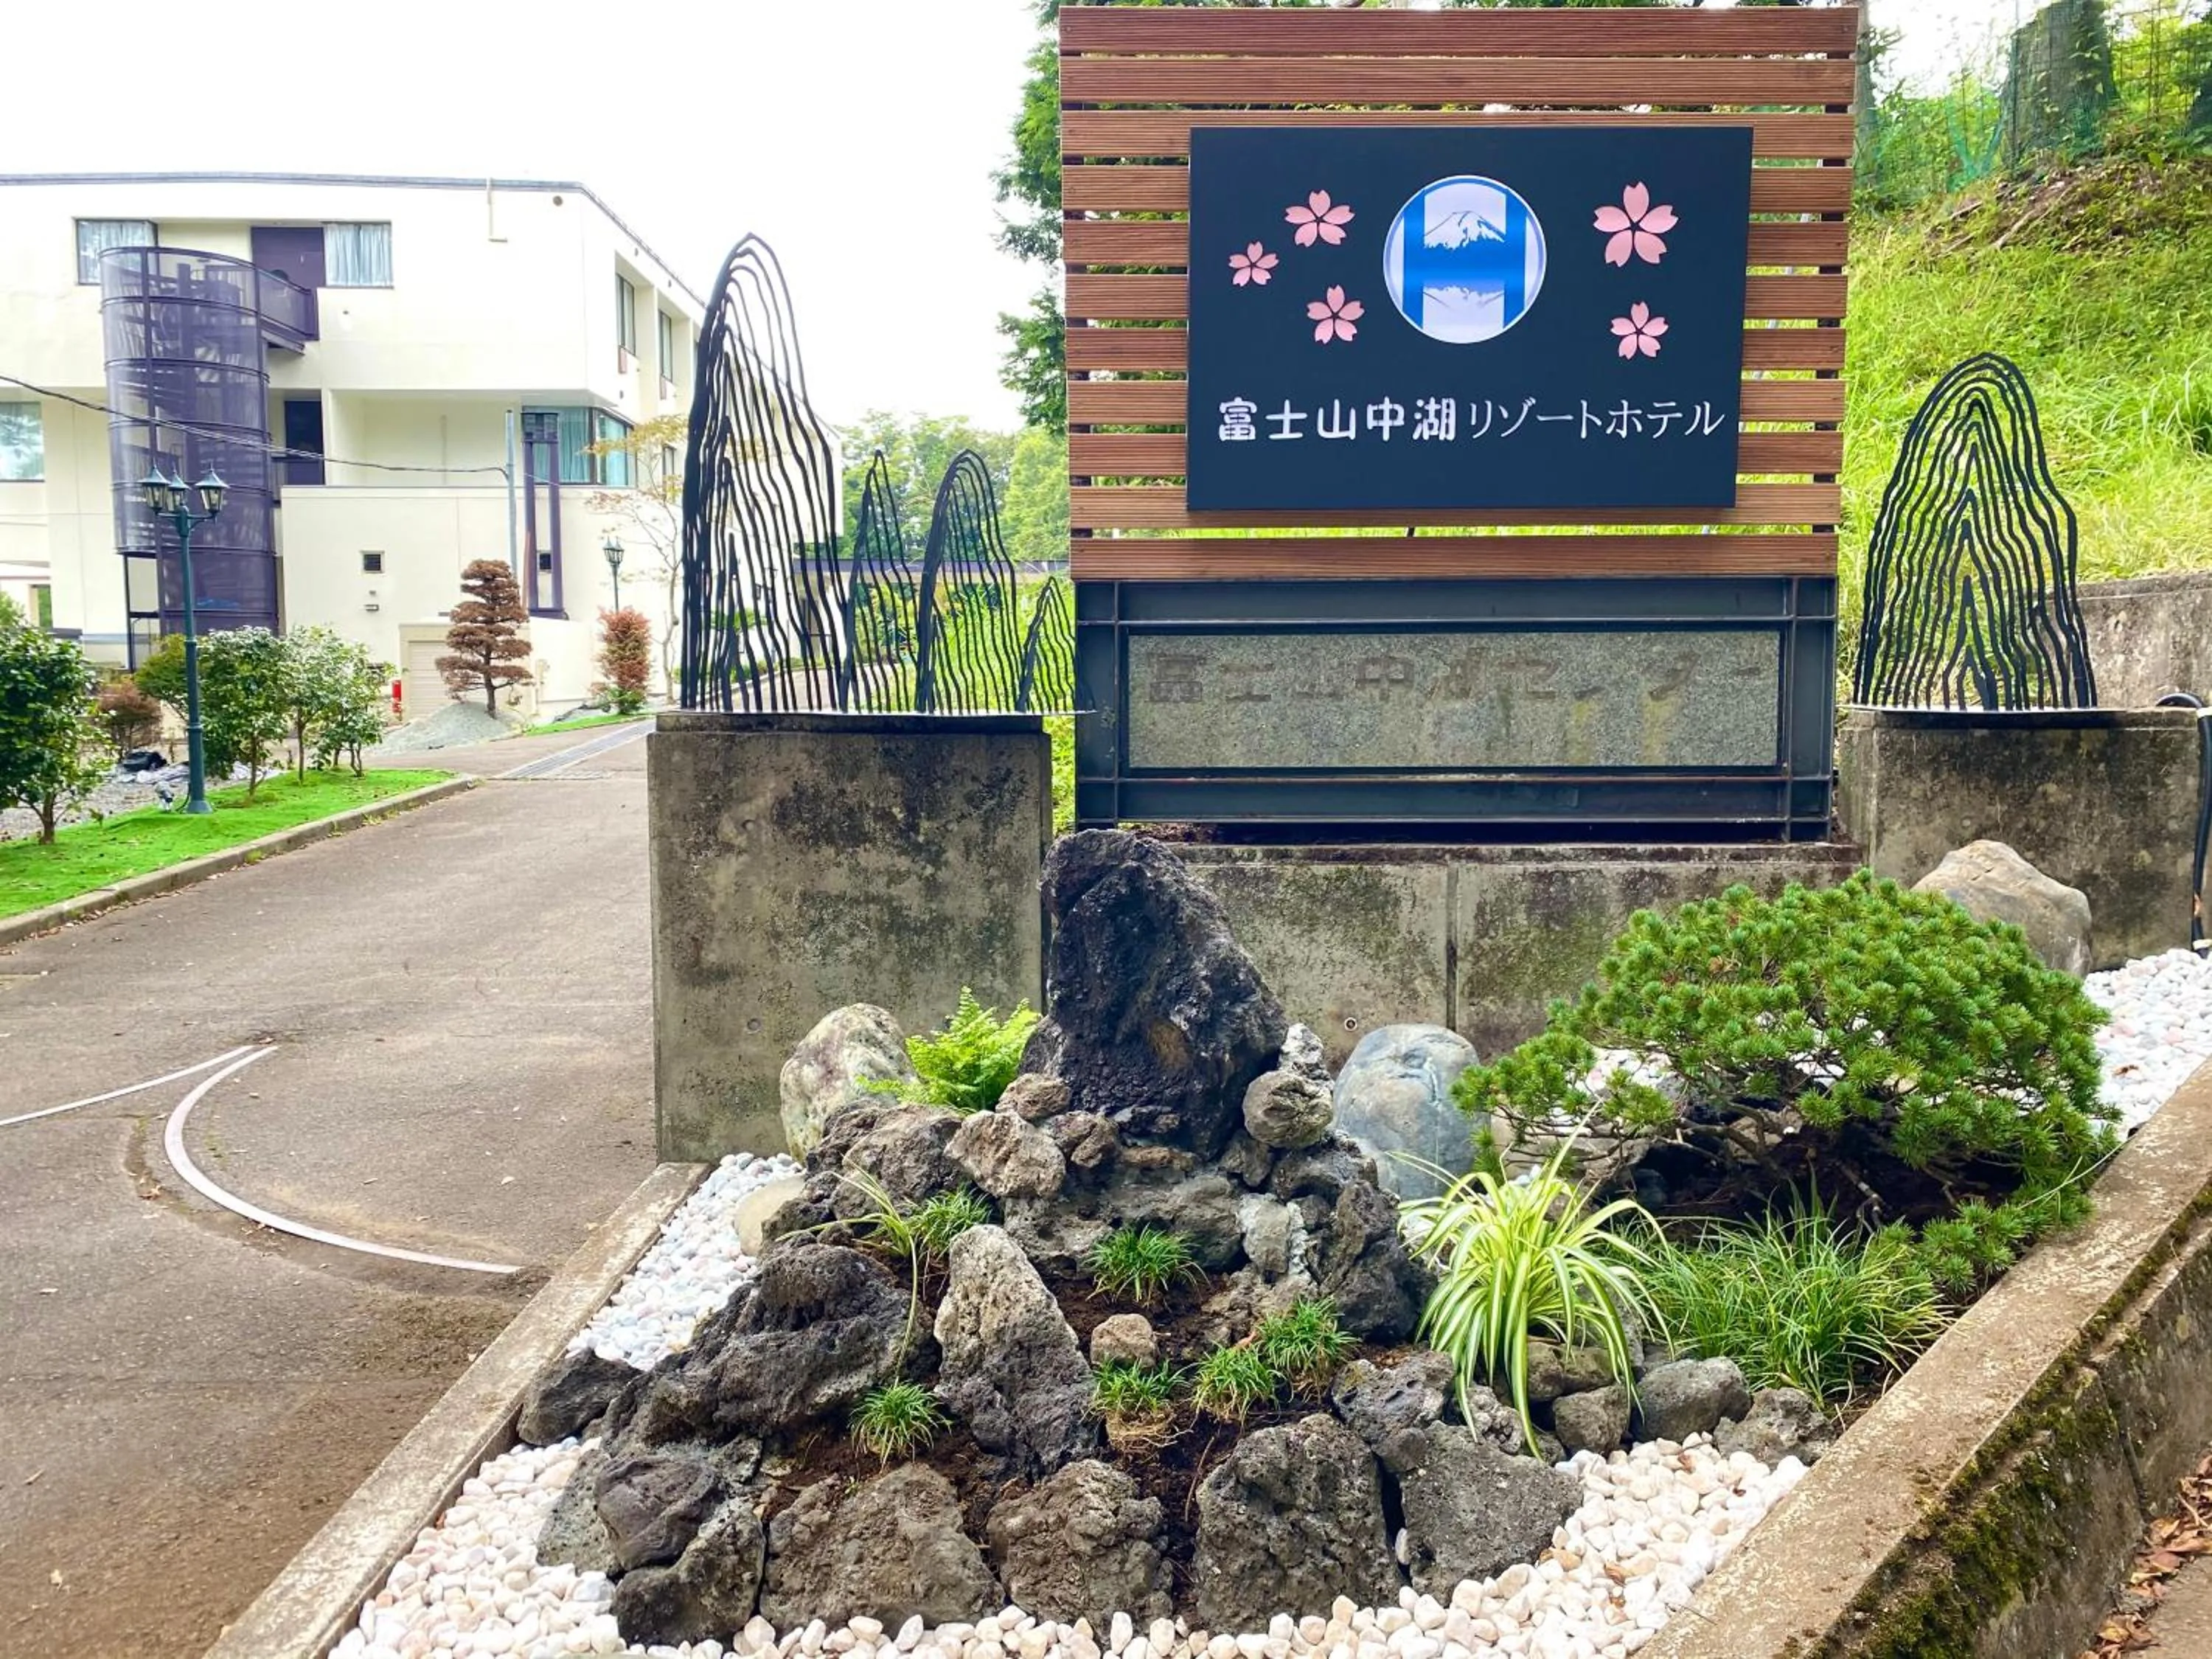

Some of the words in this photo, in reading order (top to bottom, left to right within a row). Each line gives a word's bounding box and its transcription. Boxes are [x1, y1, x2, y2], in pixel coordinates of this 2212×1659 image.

[1218, 396, 1725, 442] 富士山中湖リゾートホテル
